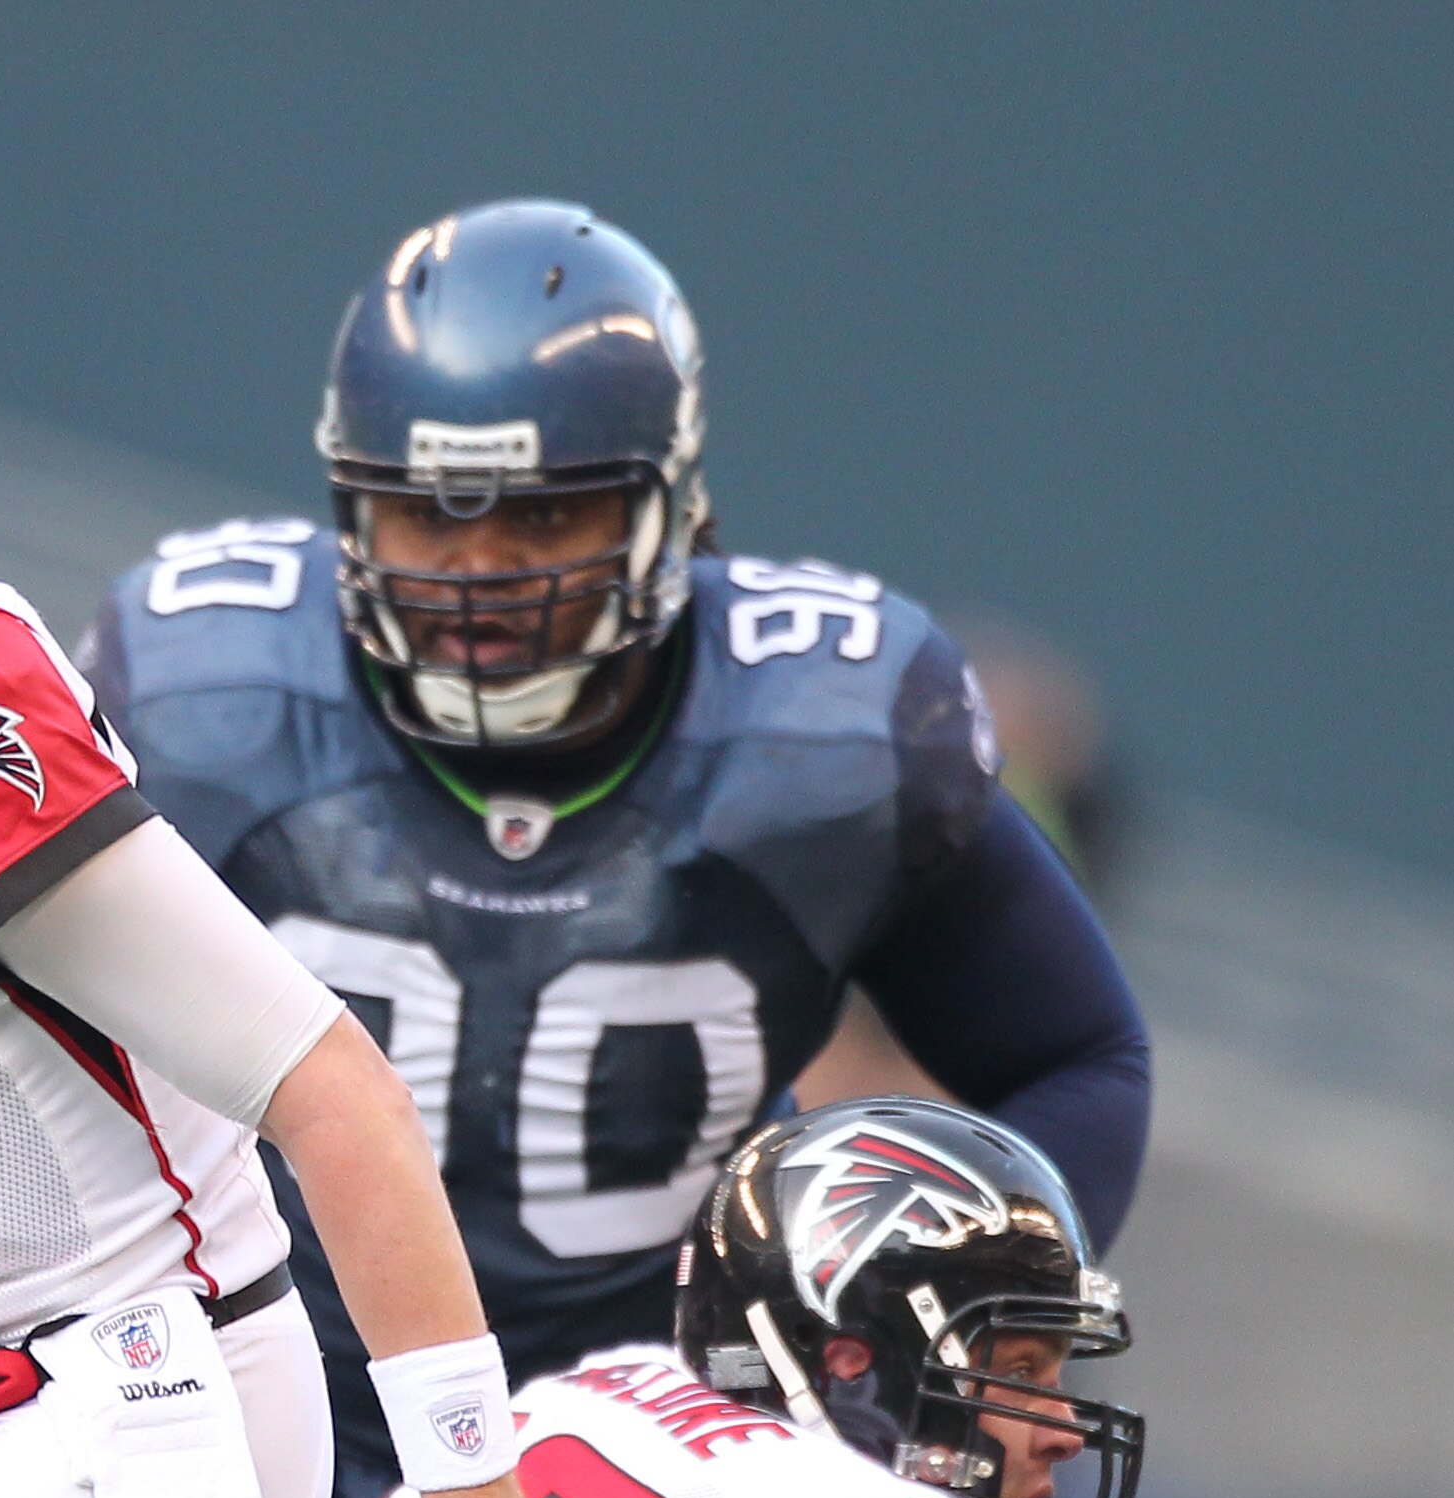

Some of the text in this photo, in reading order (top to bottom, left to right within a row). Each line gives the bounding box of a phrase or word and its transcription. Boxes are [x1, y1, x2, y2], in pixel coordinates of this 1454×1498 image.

[96, 1307, 160, 1341] EQUIPMENT
[124, 1341, 163, 1369] NFL
[118, 1378, 206, 1402] Wilson
[454, 1428, 483, 1449] NFL
